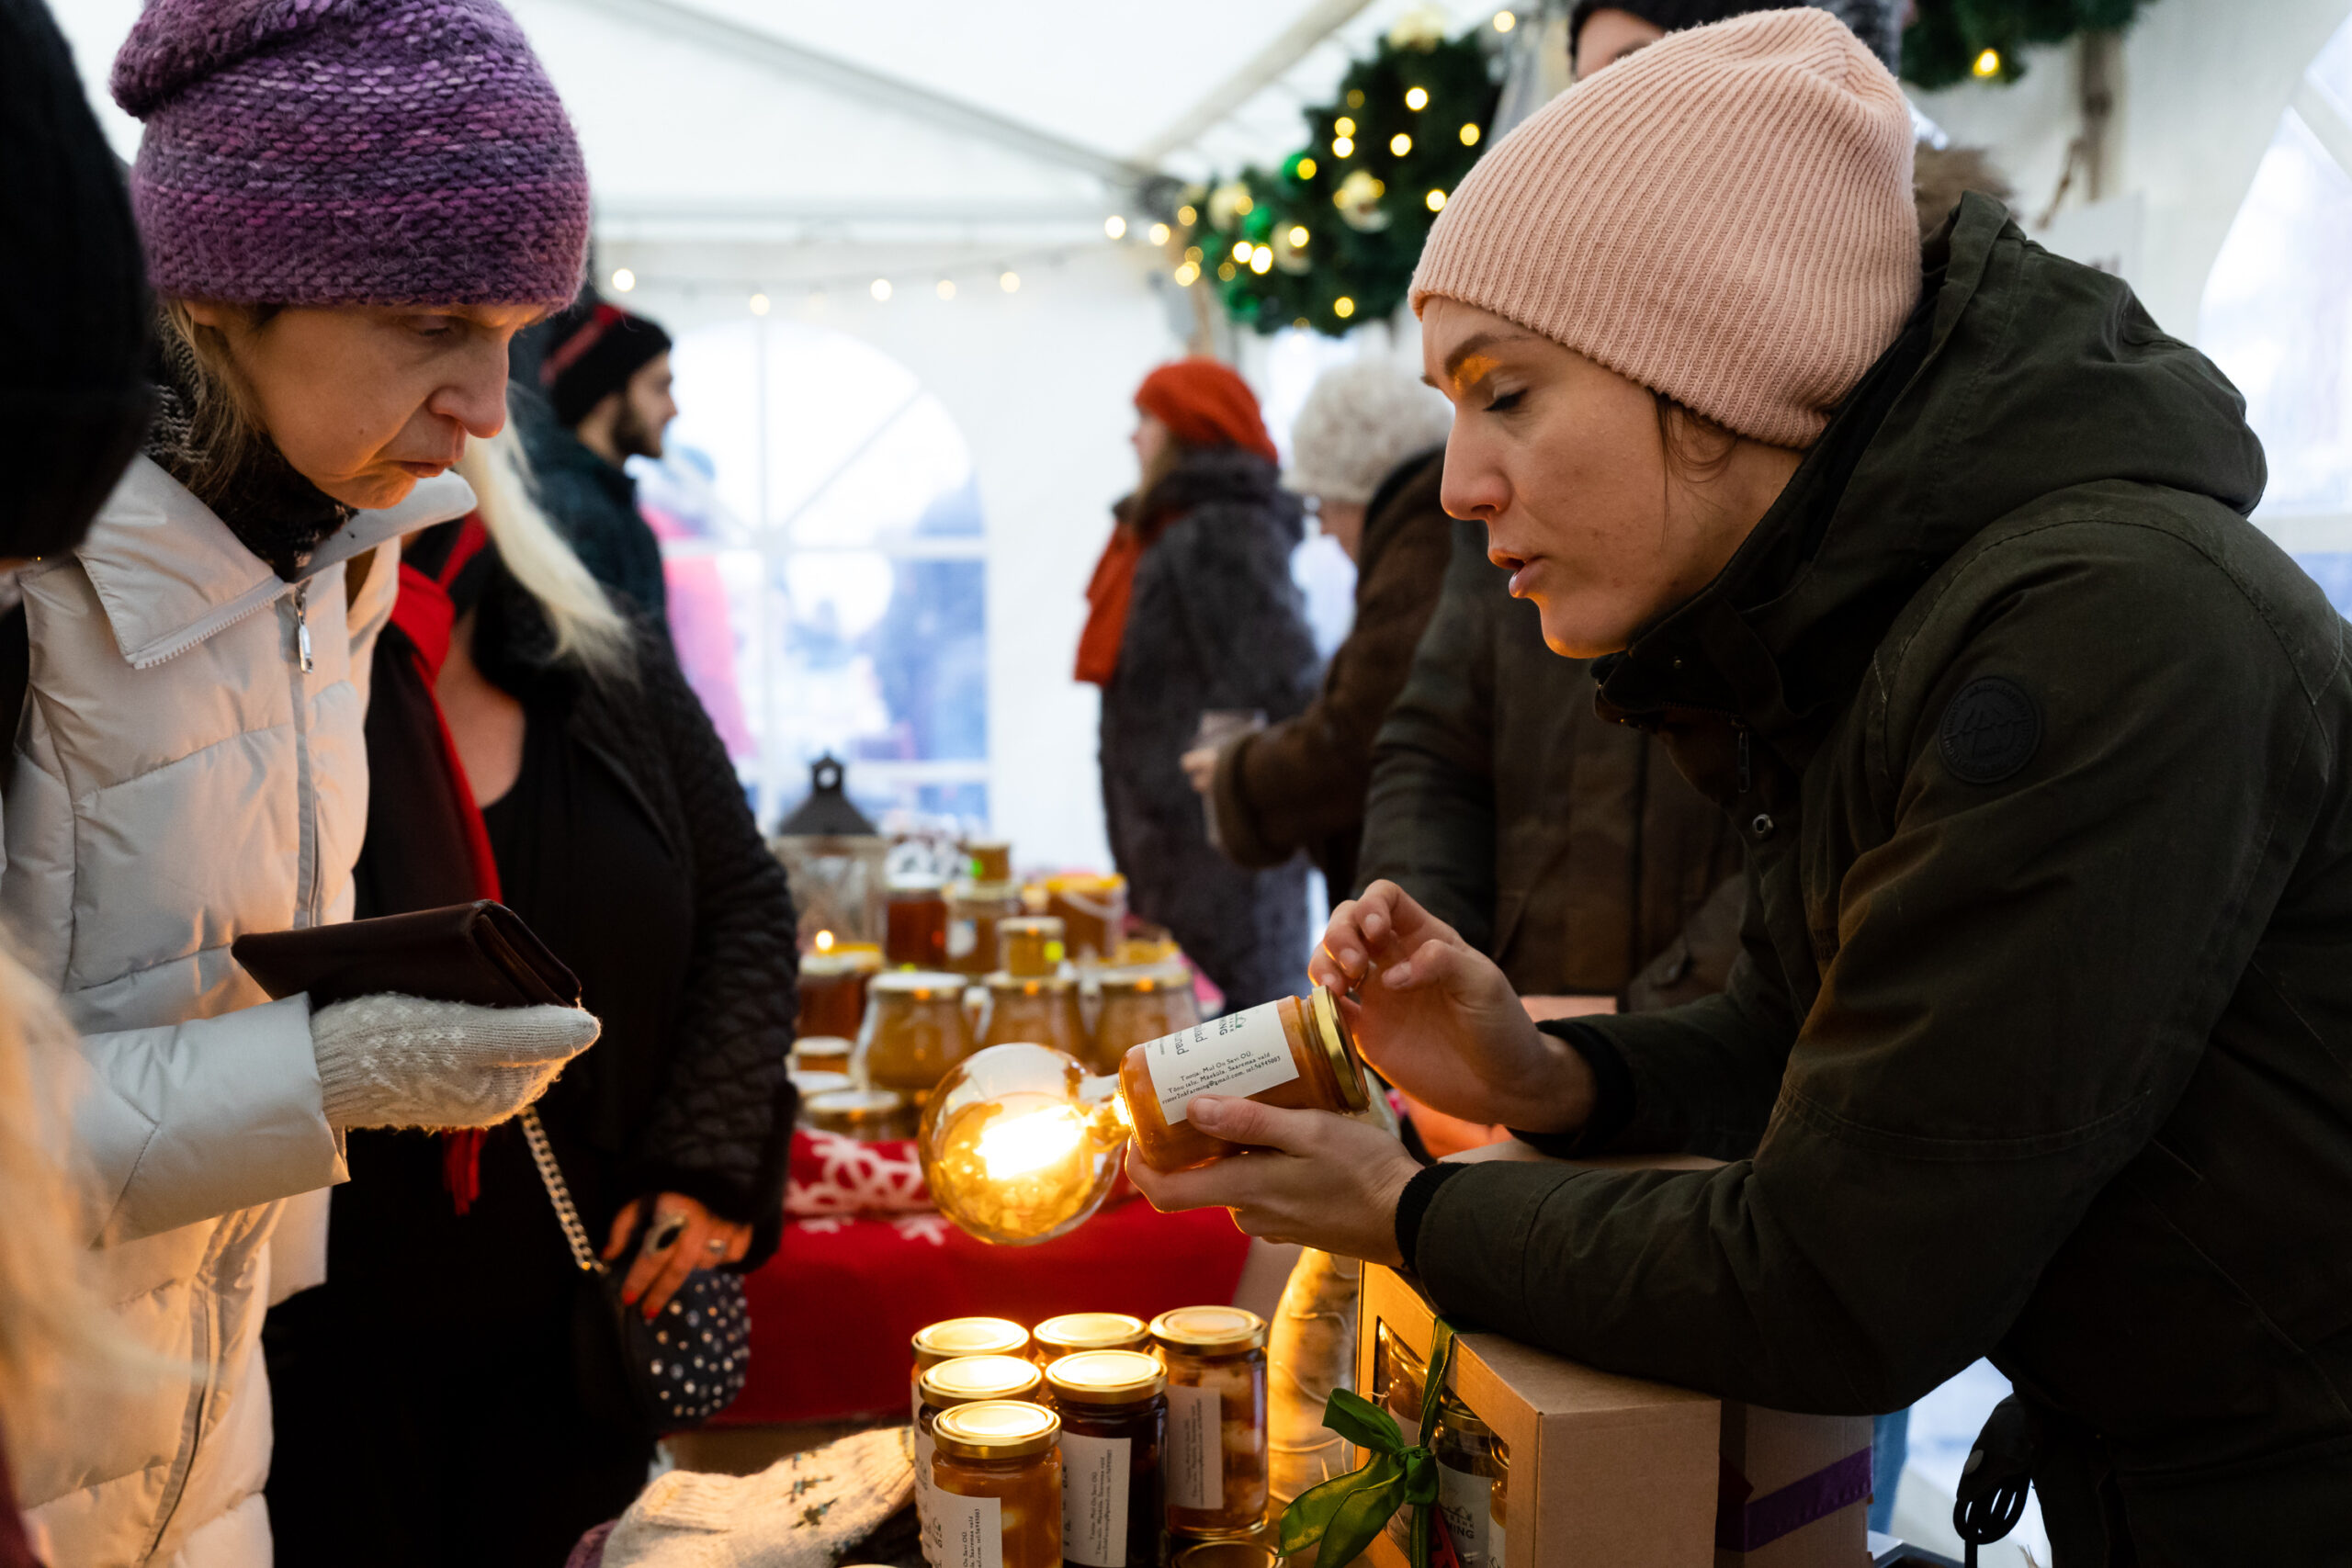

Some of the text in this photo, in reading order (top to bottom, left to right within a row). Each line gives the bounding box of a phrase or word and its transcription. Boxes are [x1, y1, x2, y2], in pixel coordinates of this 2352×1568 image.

[1202, 1065, 1215, 1073] Mul
[1227, 1056, 1239, 1066] Savi
[1227, 1058, 1257, 1072] Saaremaa
[1257, 1052, 1271, 1062] vald
